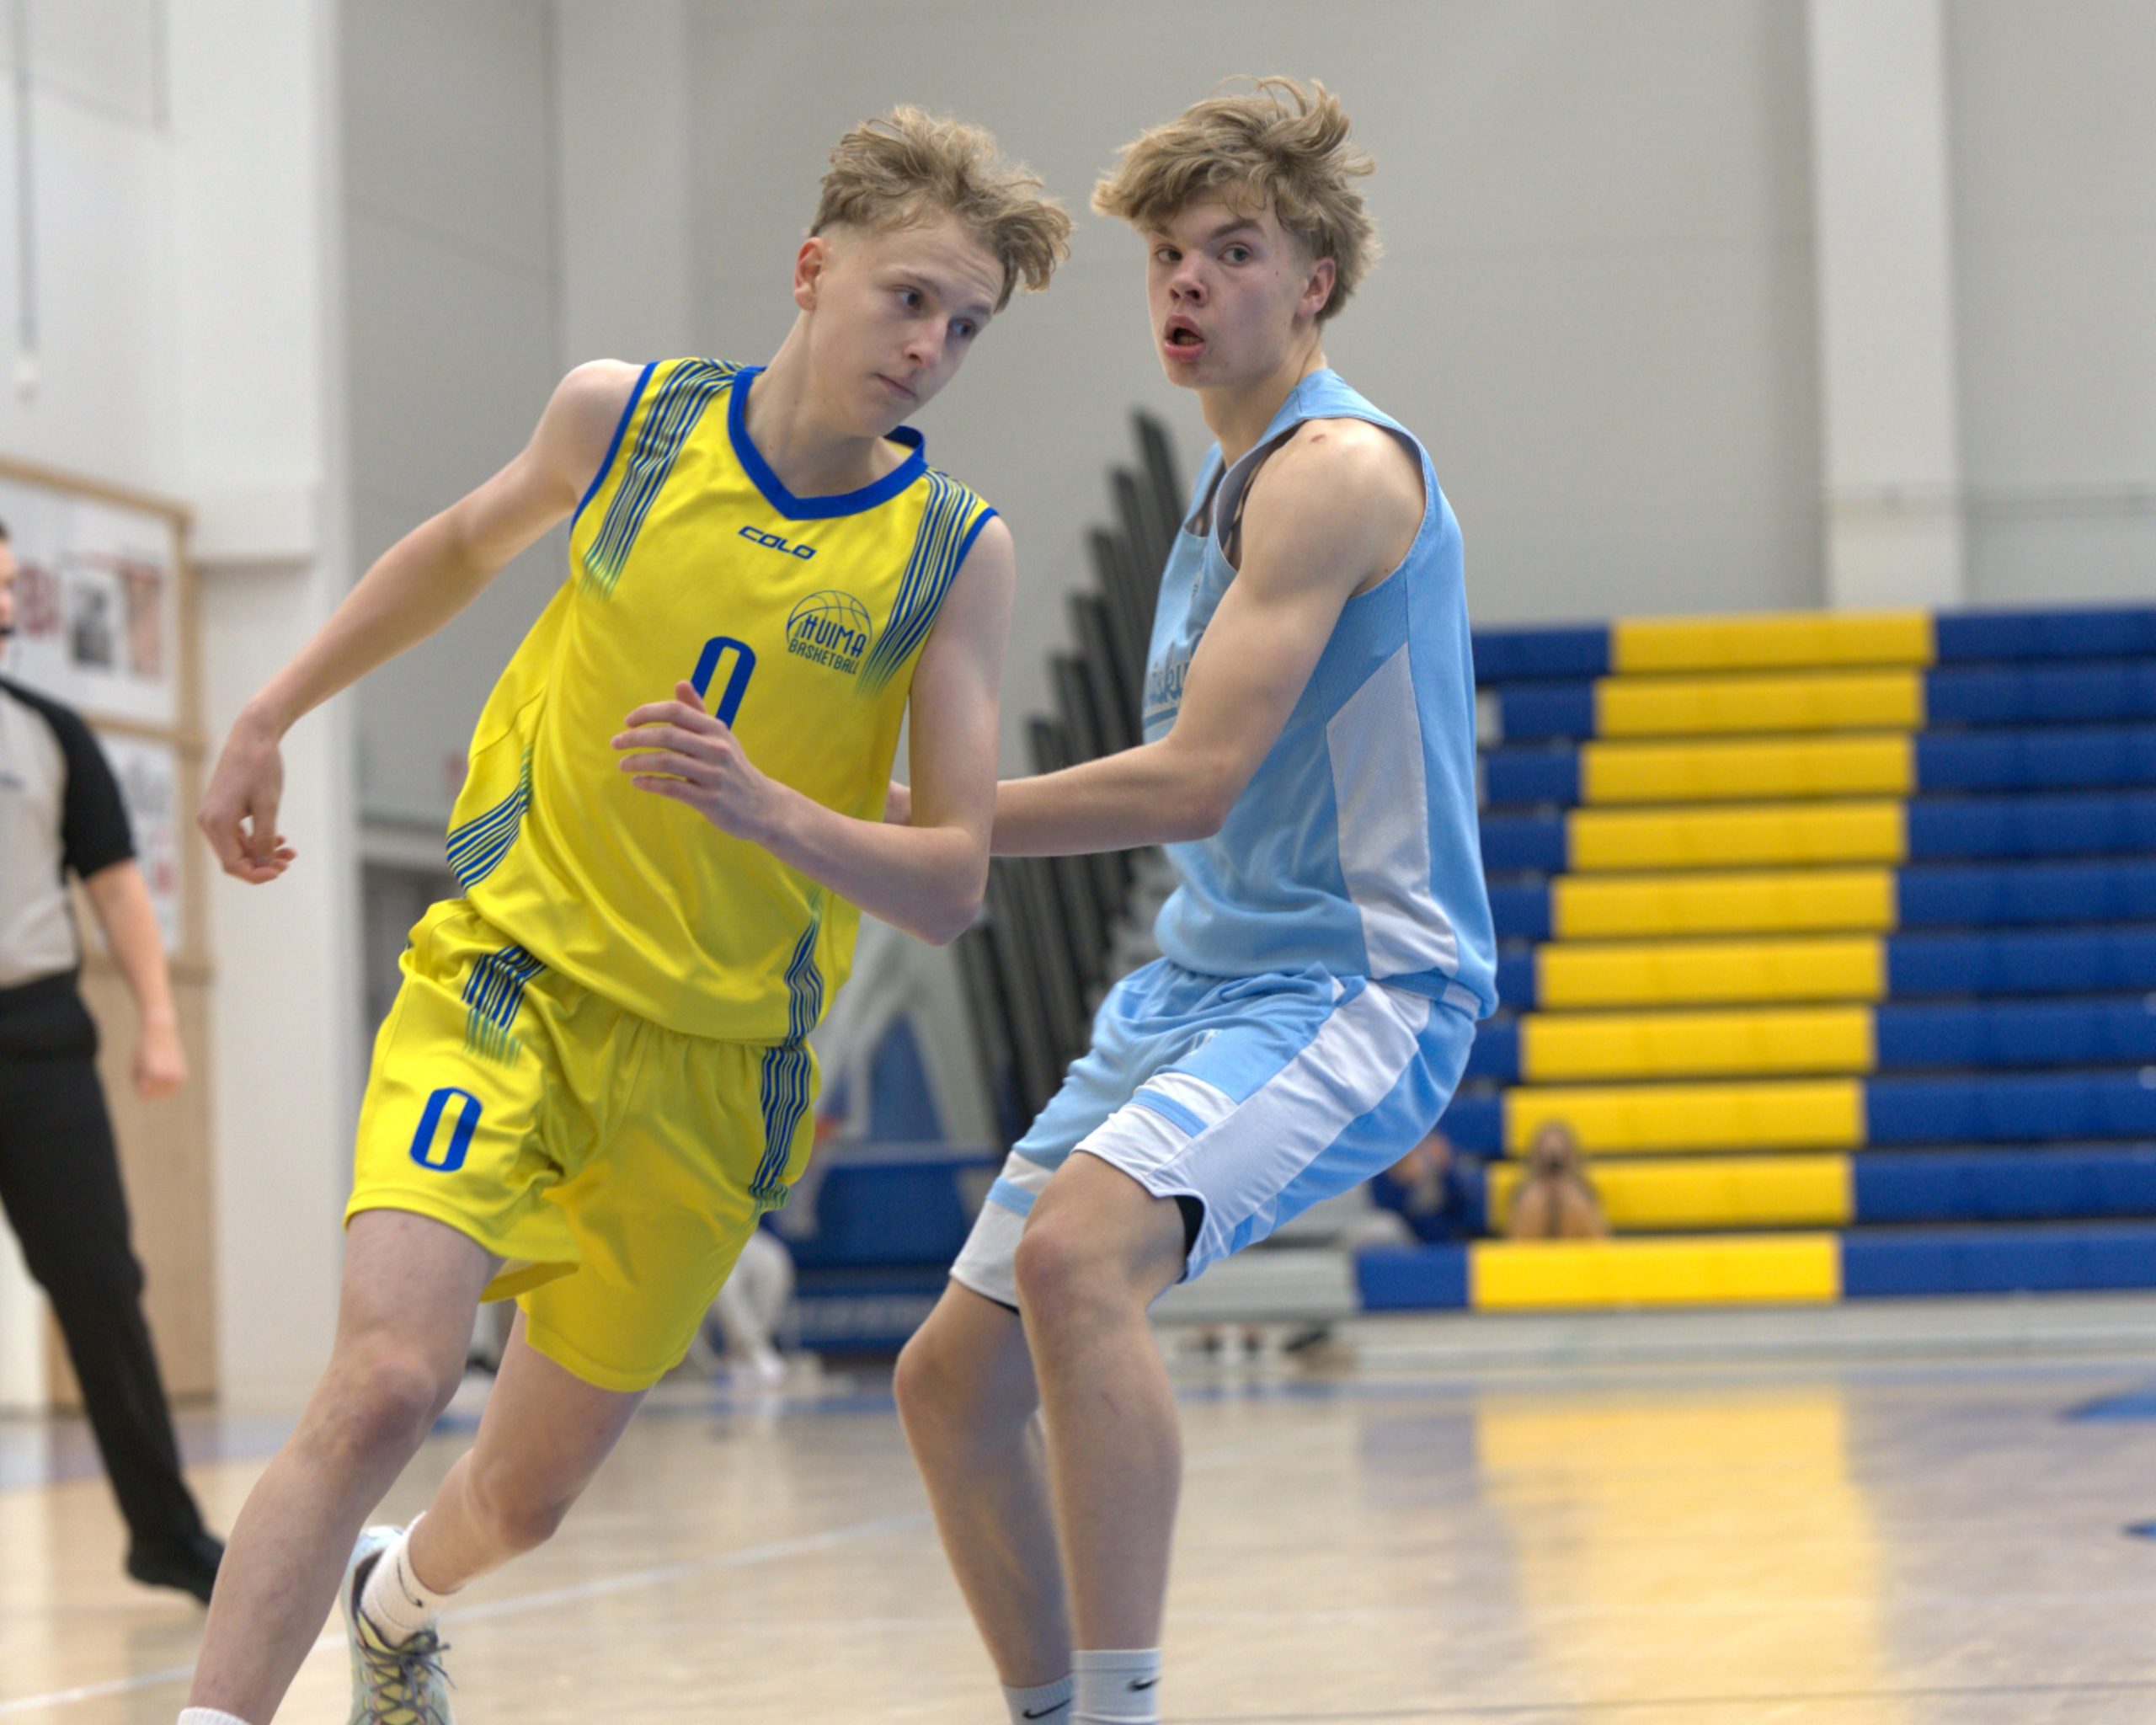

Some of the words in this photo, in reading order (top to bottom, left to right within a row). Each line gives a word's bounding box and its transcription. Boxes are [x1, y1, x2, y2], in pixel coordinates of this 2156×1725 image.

[738, 526, 817, 560] COLO
[800, 614, 867, 658] HUIMA
[787, 638, 859, 675] BASKETBALL
[409, 1087, 483, 1172] 0
